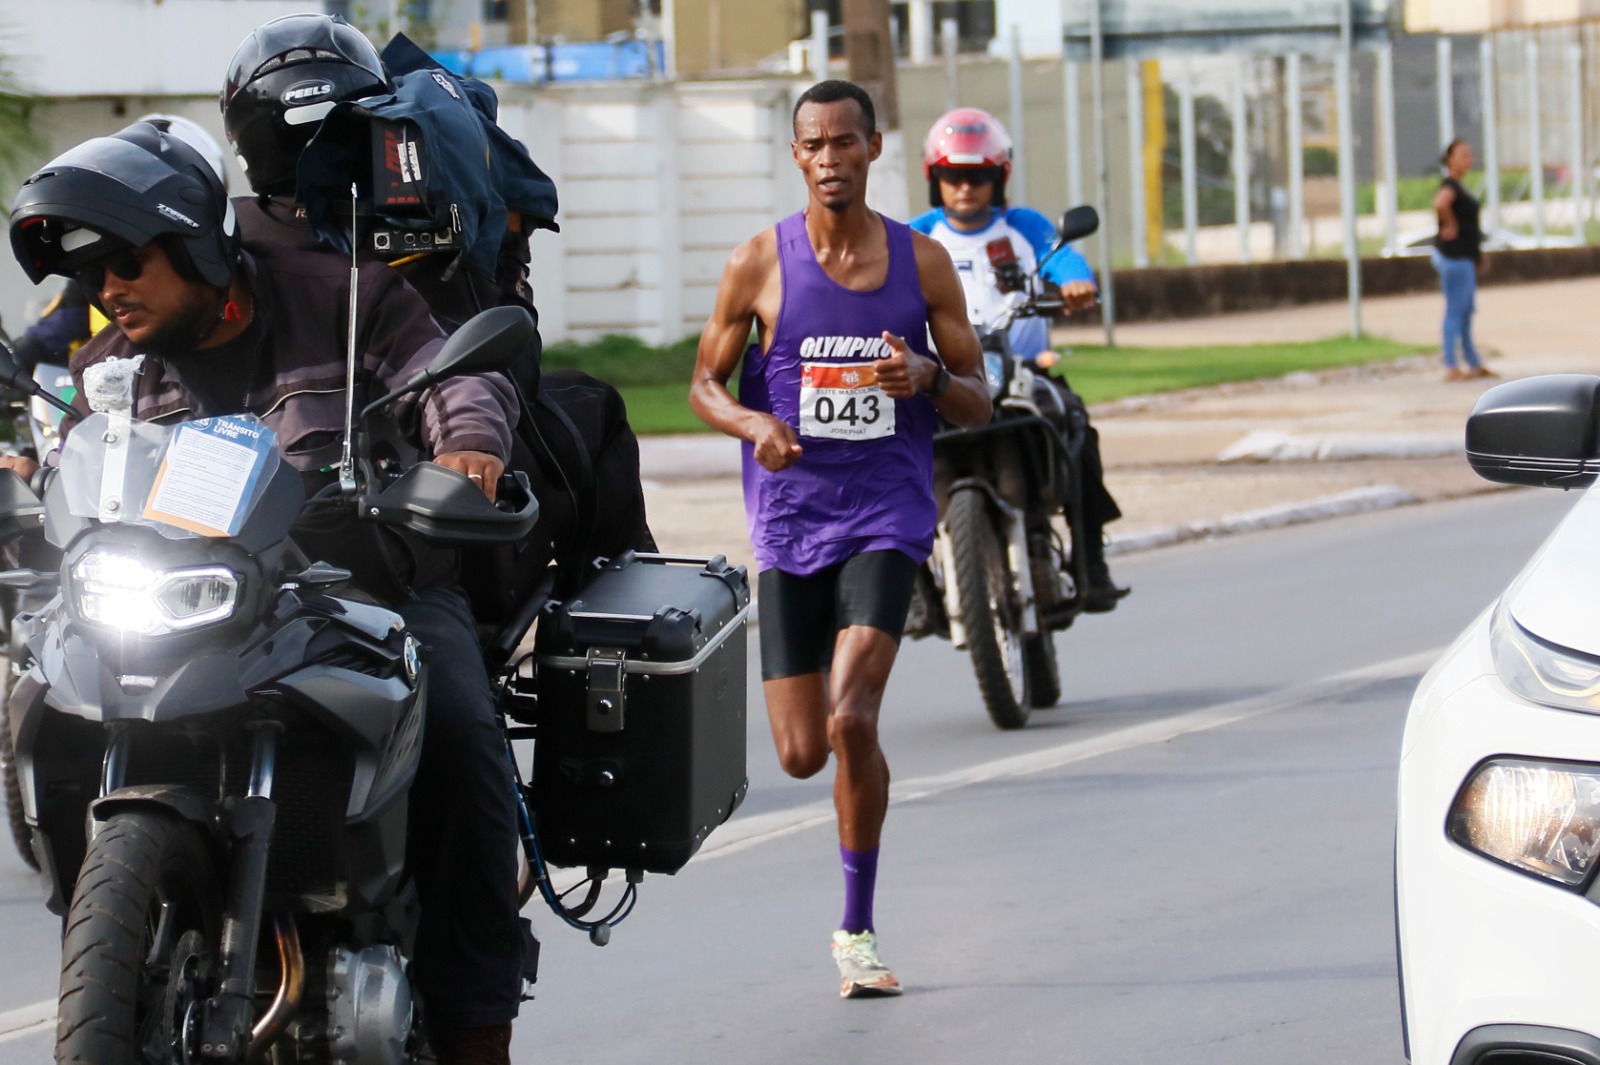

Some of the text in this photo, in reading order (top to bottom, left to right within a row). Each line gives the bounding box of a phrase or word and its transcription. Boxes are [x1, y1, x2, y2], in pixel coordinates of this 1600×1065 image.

[285, 84, 331, 101] PEELS
[800, 336, 904, 358] OLYMPIKU
[838, 386, 879, 395] MASCULINO
[815, 395, 880, 426] 043
[213, 425, 239, 439] LIVRE
[217, 418, 260, 439] TRÂNSITO
